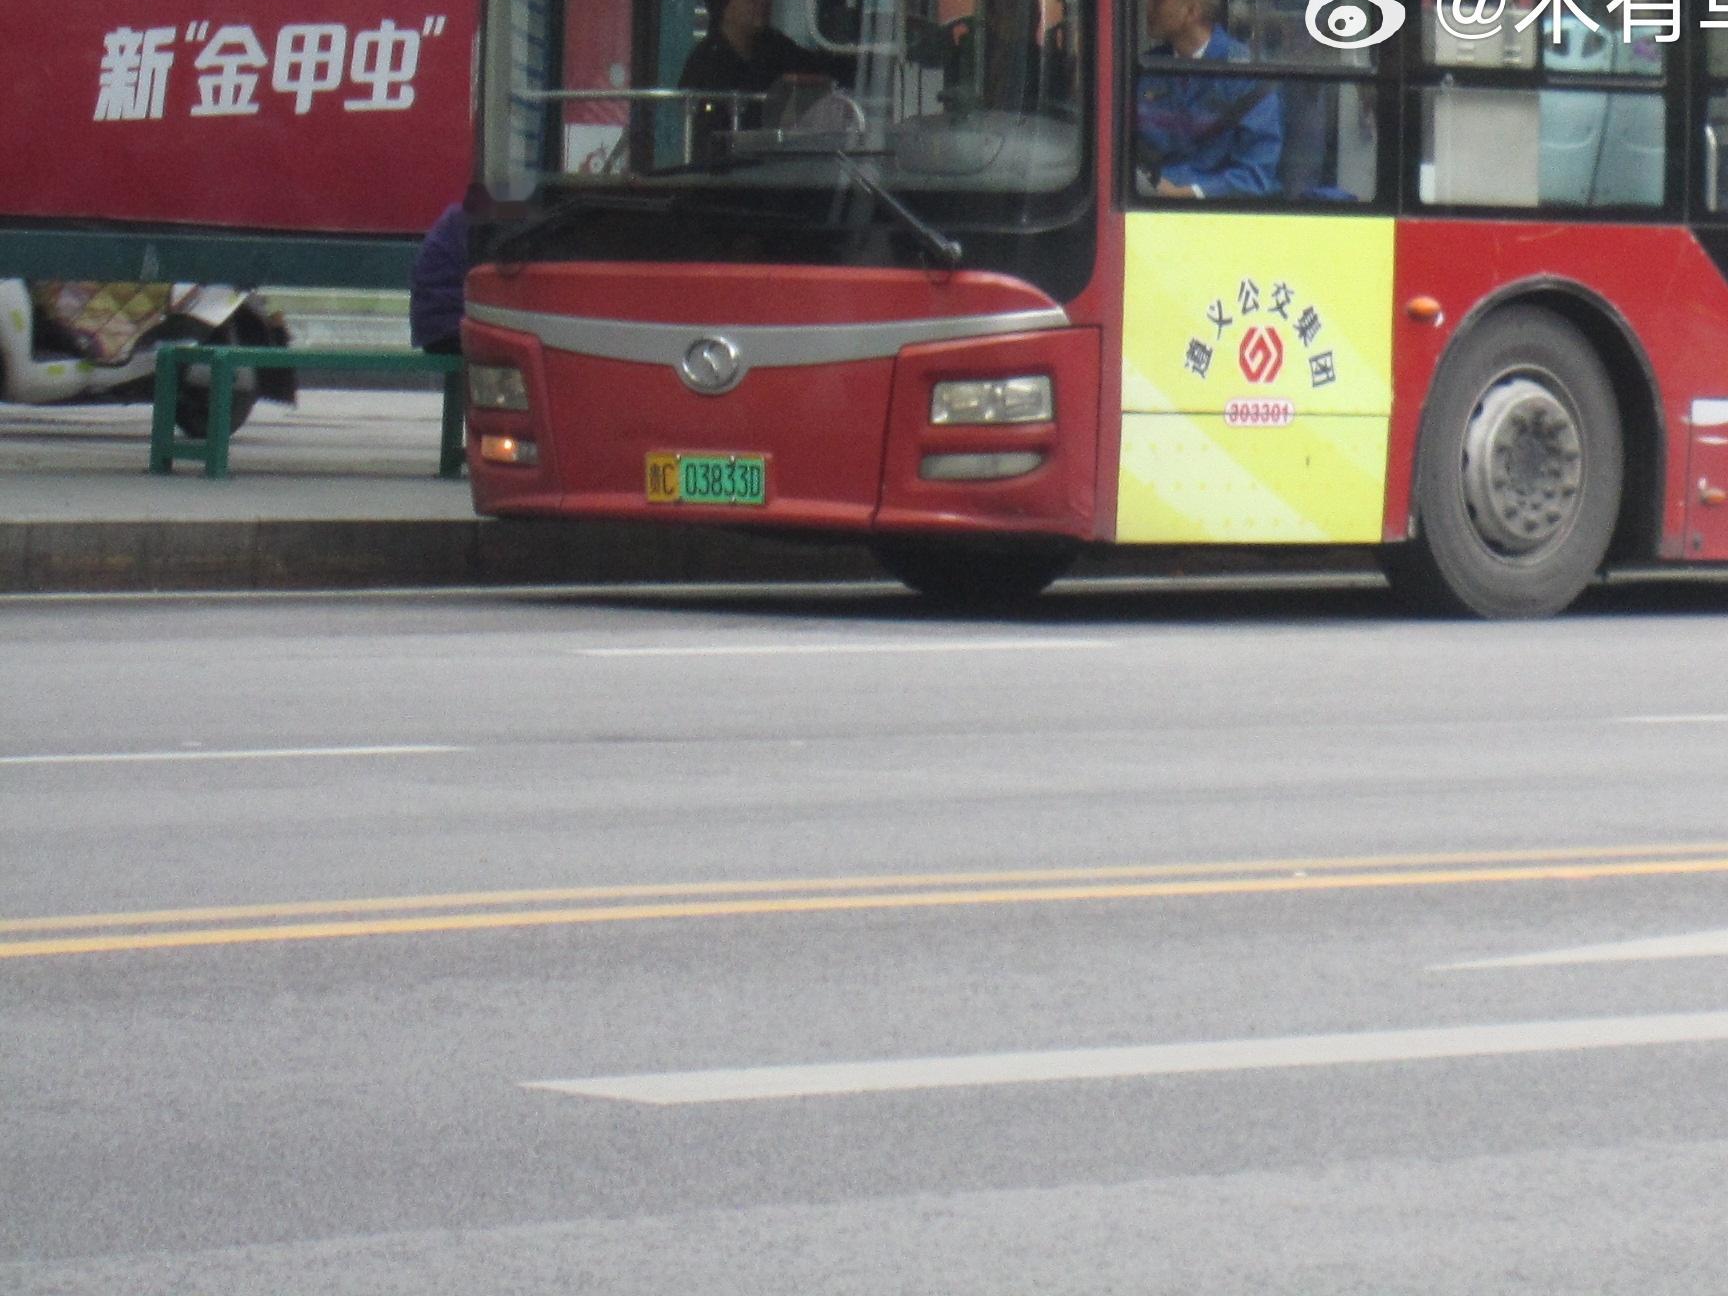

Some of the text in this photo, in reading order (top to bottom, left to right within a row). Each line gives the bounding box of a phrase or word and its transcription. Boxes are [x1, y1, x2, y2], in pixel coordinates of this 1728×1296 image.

[1185, 279, 1336, 388] 遵义公交集团
